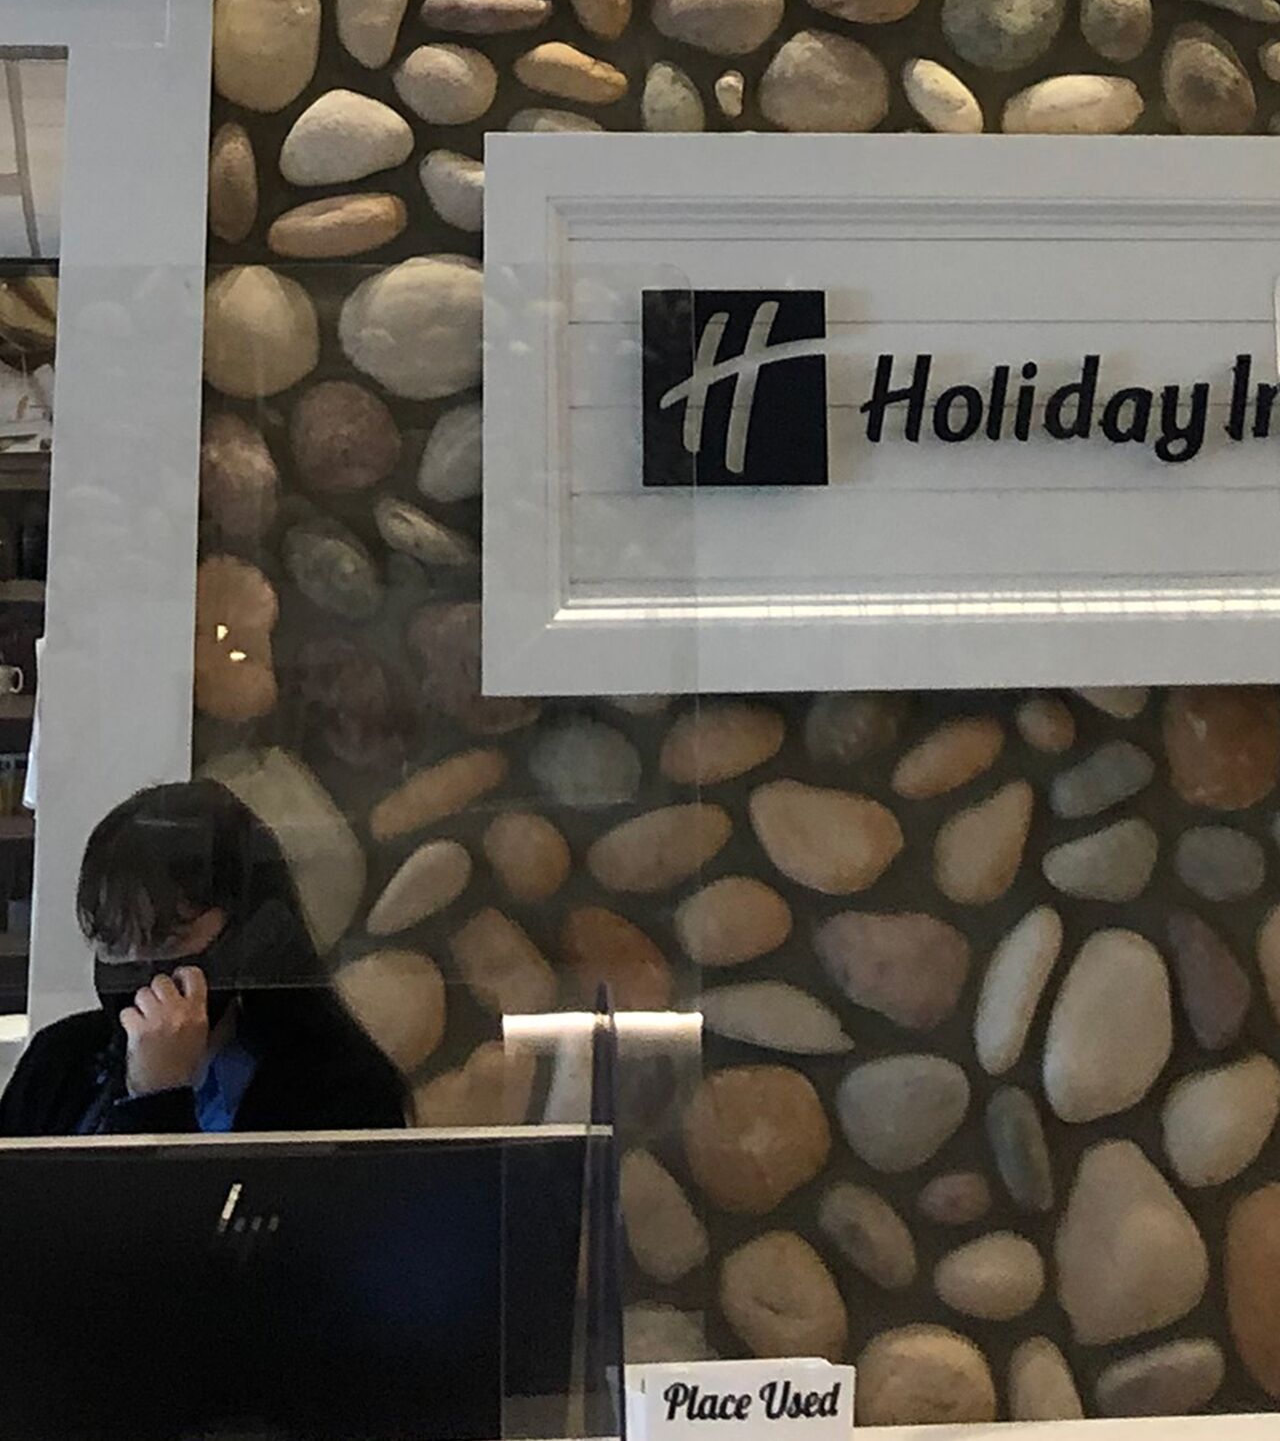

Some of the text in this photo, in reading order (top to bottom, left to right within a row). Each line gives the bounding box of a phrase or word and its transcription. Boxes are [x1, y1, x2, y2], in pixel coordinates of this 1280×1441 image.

[860, 353, 1210, 464] Holiday
[662, 1380, 842, 1421] Place Used
